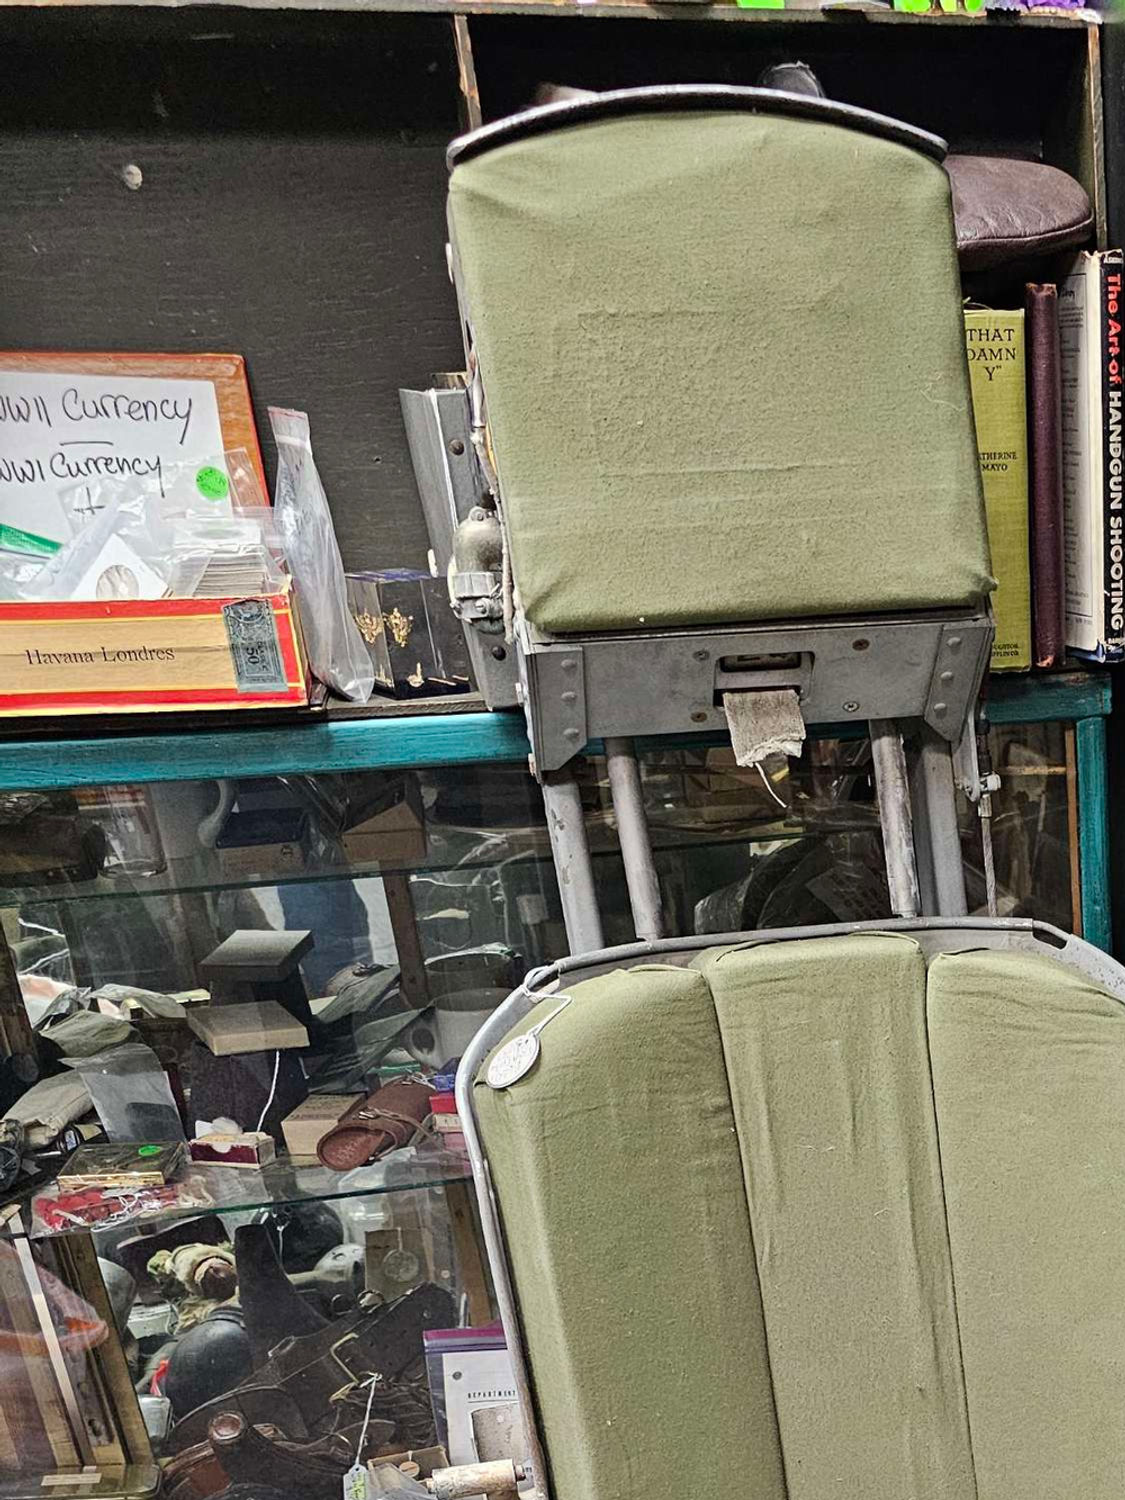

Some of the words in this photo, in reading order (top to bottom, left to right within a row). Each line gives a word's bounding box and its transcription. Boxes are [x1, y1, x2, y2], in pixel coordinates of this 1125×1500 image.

[1107, 273, 1121, 313] The
[966, 328, 1015, 341] THAT
[1108, 319, 1121, 355] Art
[1109, 359, 1122, 384] of
[62, 388, 192, 445] Currency
[1108, 391, 1123, 510] HANDGUN
[50, 452, 165, 498] Currency
[1110, 516, 1125, 630] SHOOTING
[26, 648, 94, 665] Havana
[101, 645, 176, 662] Londres
[467, 1390, 516, 1399] DEPARTMENT
